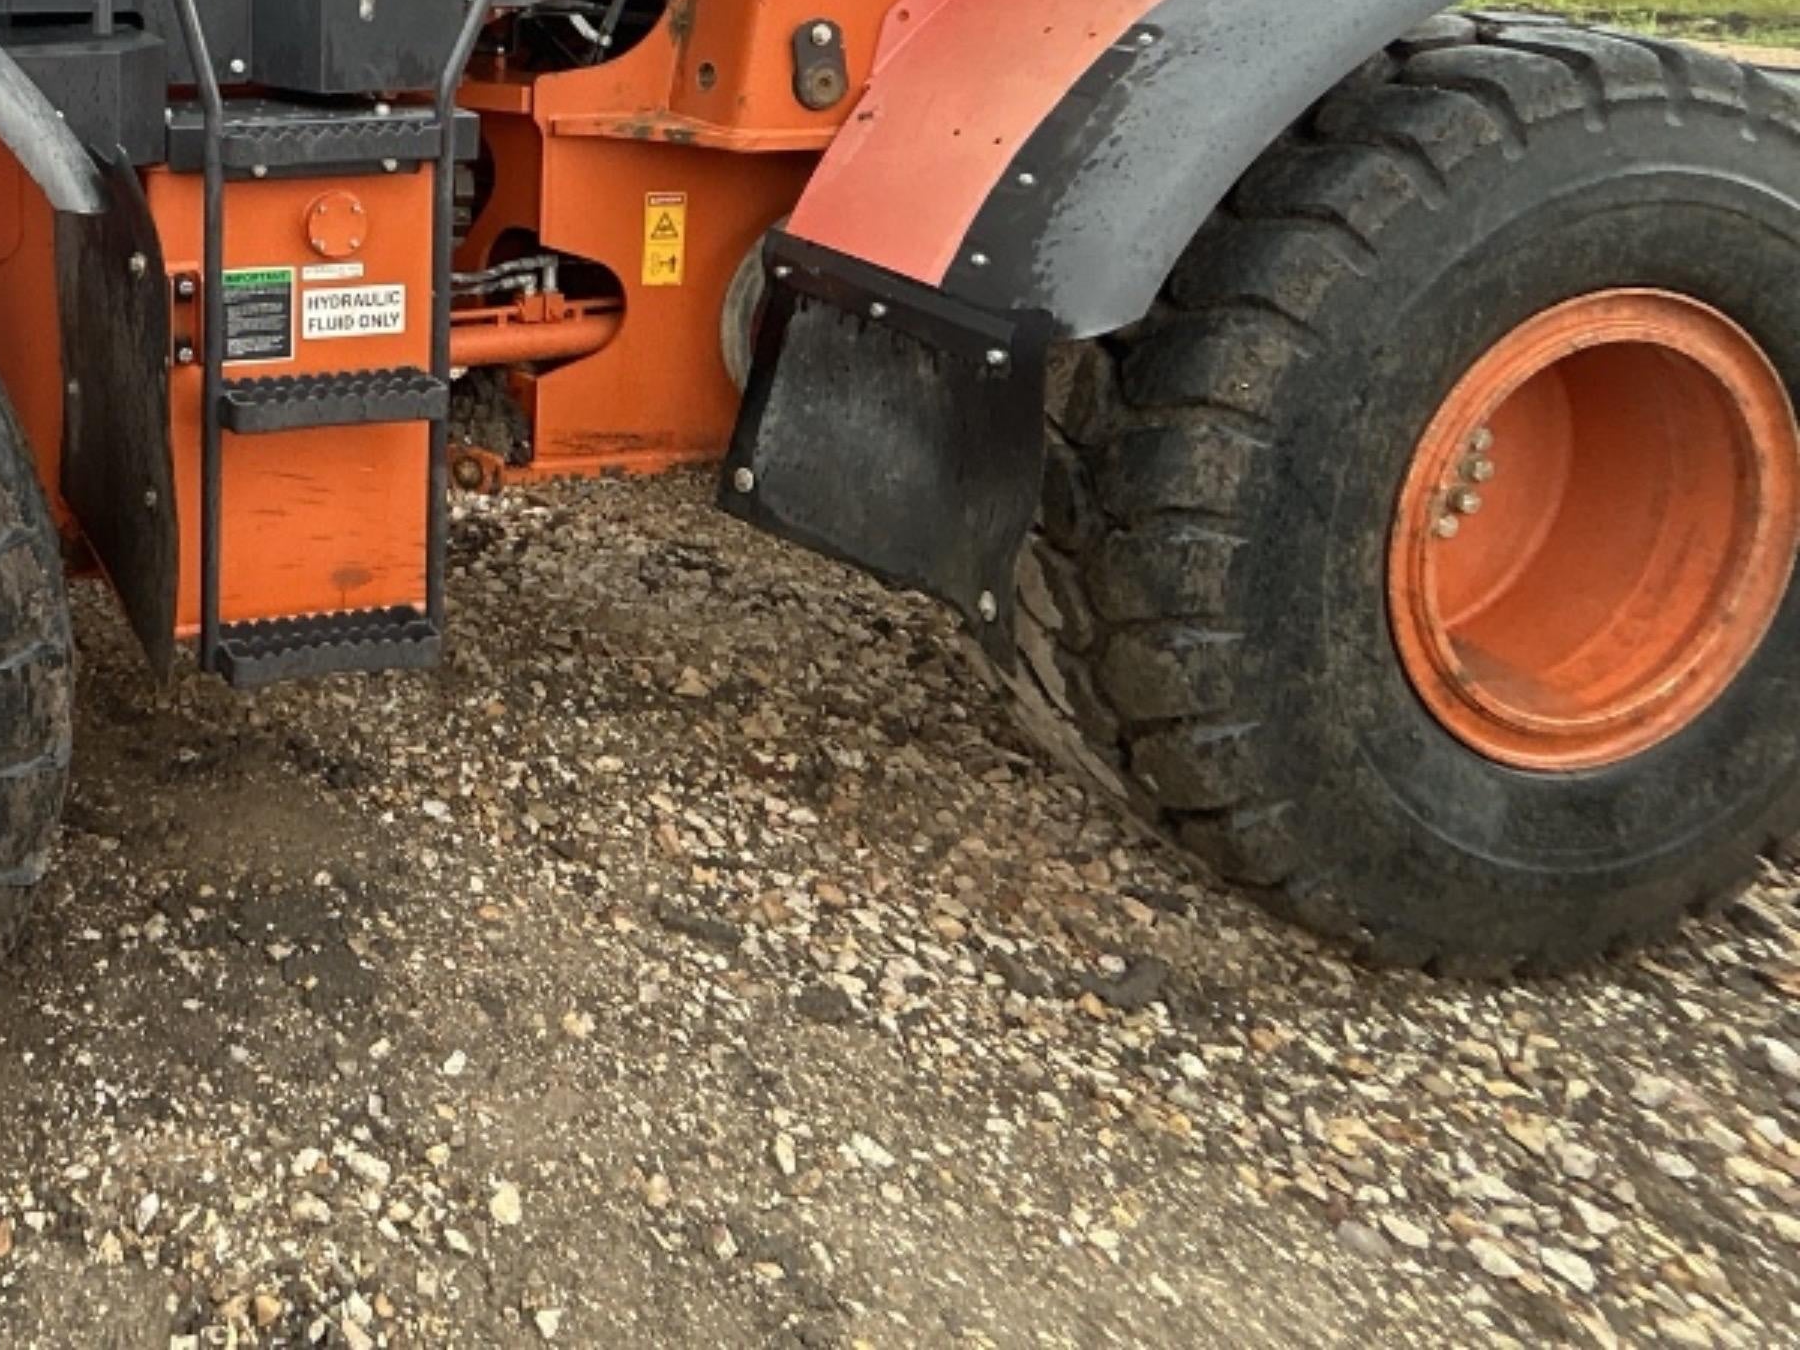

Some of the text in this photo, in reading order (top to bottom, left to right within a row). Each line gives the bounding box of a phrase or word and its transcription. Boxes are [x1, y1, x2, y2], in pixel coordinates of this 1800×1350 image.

[308, 290, 402, 310] HYDRAULIC
[308, 315, 354, 332] FLUID
[358, 311, 402, 329] ONLY
